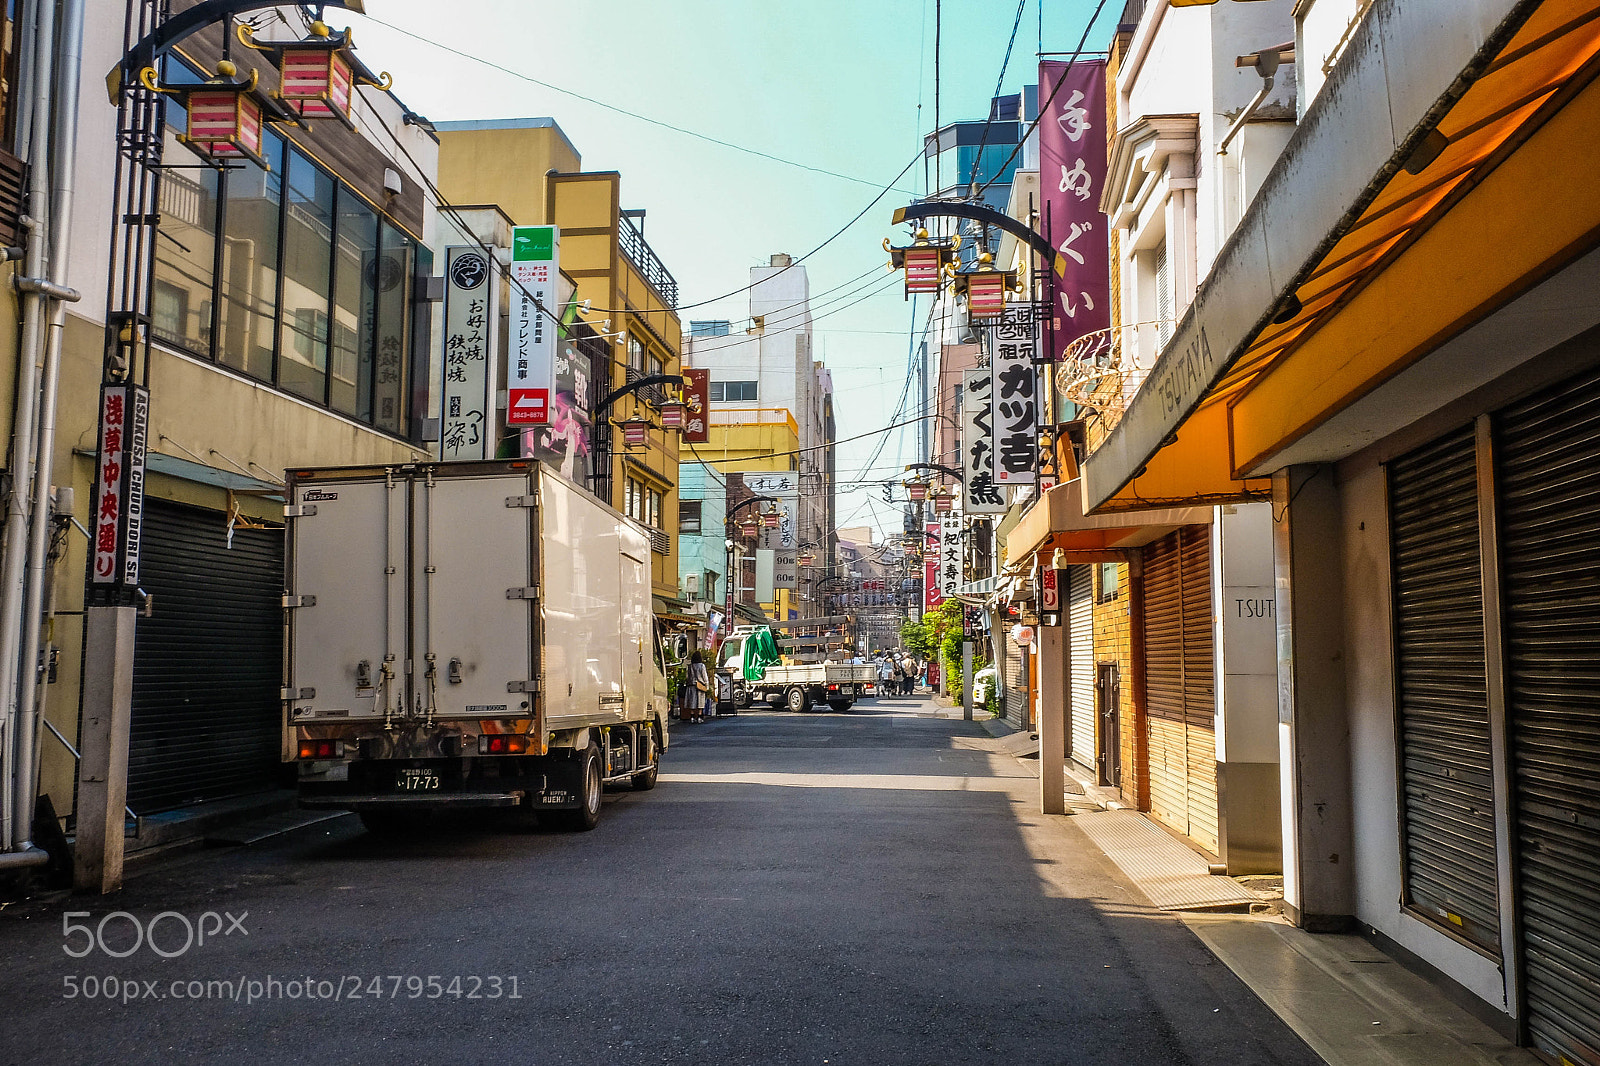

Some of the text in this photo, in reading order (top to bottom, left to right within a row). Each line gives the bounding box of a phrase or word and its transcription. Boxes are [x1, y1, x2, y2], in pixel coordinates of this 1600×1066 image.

[1057, 89, 1095, 318] 手ぬぐい
[447, 334, 467, 383] 鉄板焼
[465, 299, 486, 361] お好み焼
[1158, 326, 1213, 421] TSUTAYA
[132, 392, 148, 470] ASAKUSA
[999, 363, 1037, 473] カツ吉
[96, 394, 124, 577] 浅草中央通り
[129, 472, 144, 514] CHUO
[126, 518, 141, 559] DORI
[406, 776, 439, 790] 17-73
